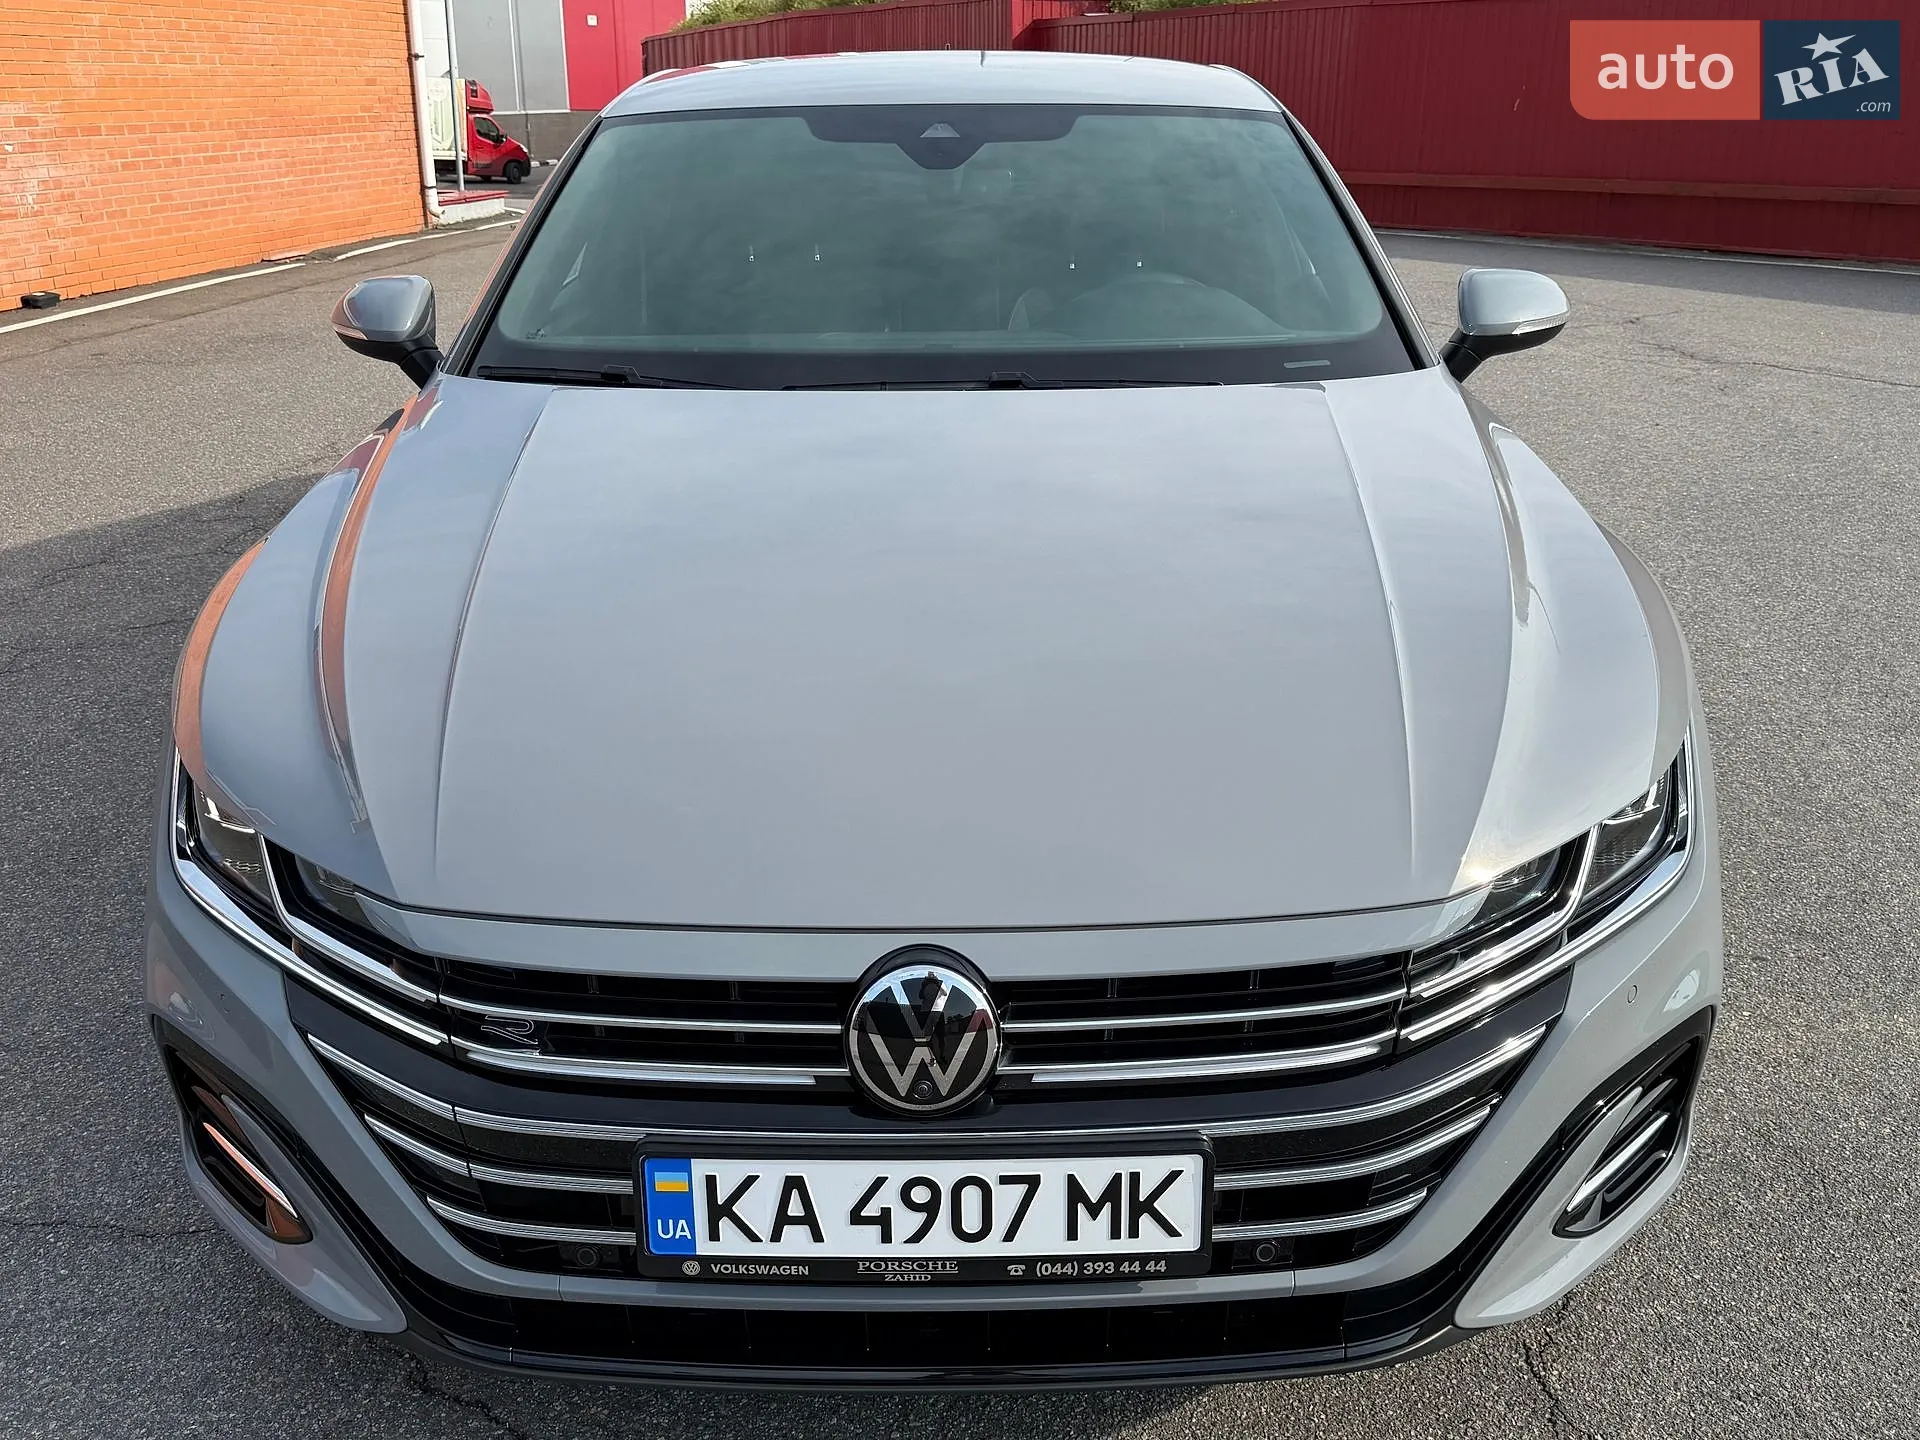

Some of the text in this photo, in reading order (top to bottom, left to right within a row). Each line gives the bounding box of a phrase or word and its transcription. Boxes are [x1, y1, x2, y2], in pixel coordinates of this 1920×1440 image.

[705, 1169, 1185, 1245] KA 4907 MK
[657, 1219, 691, 1240] UA
[711, 1263, 809, 1276] VOLKSWAGEN
[857, 1260, 959, 1272] PORSCHE
[1036, 1259, 1167, 1277] (044) 393 44 44
[884, 1273, 932, 1282] ZAHID
